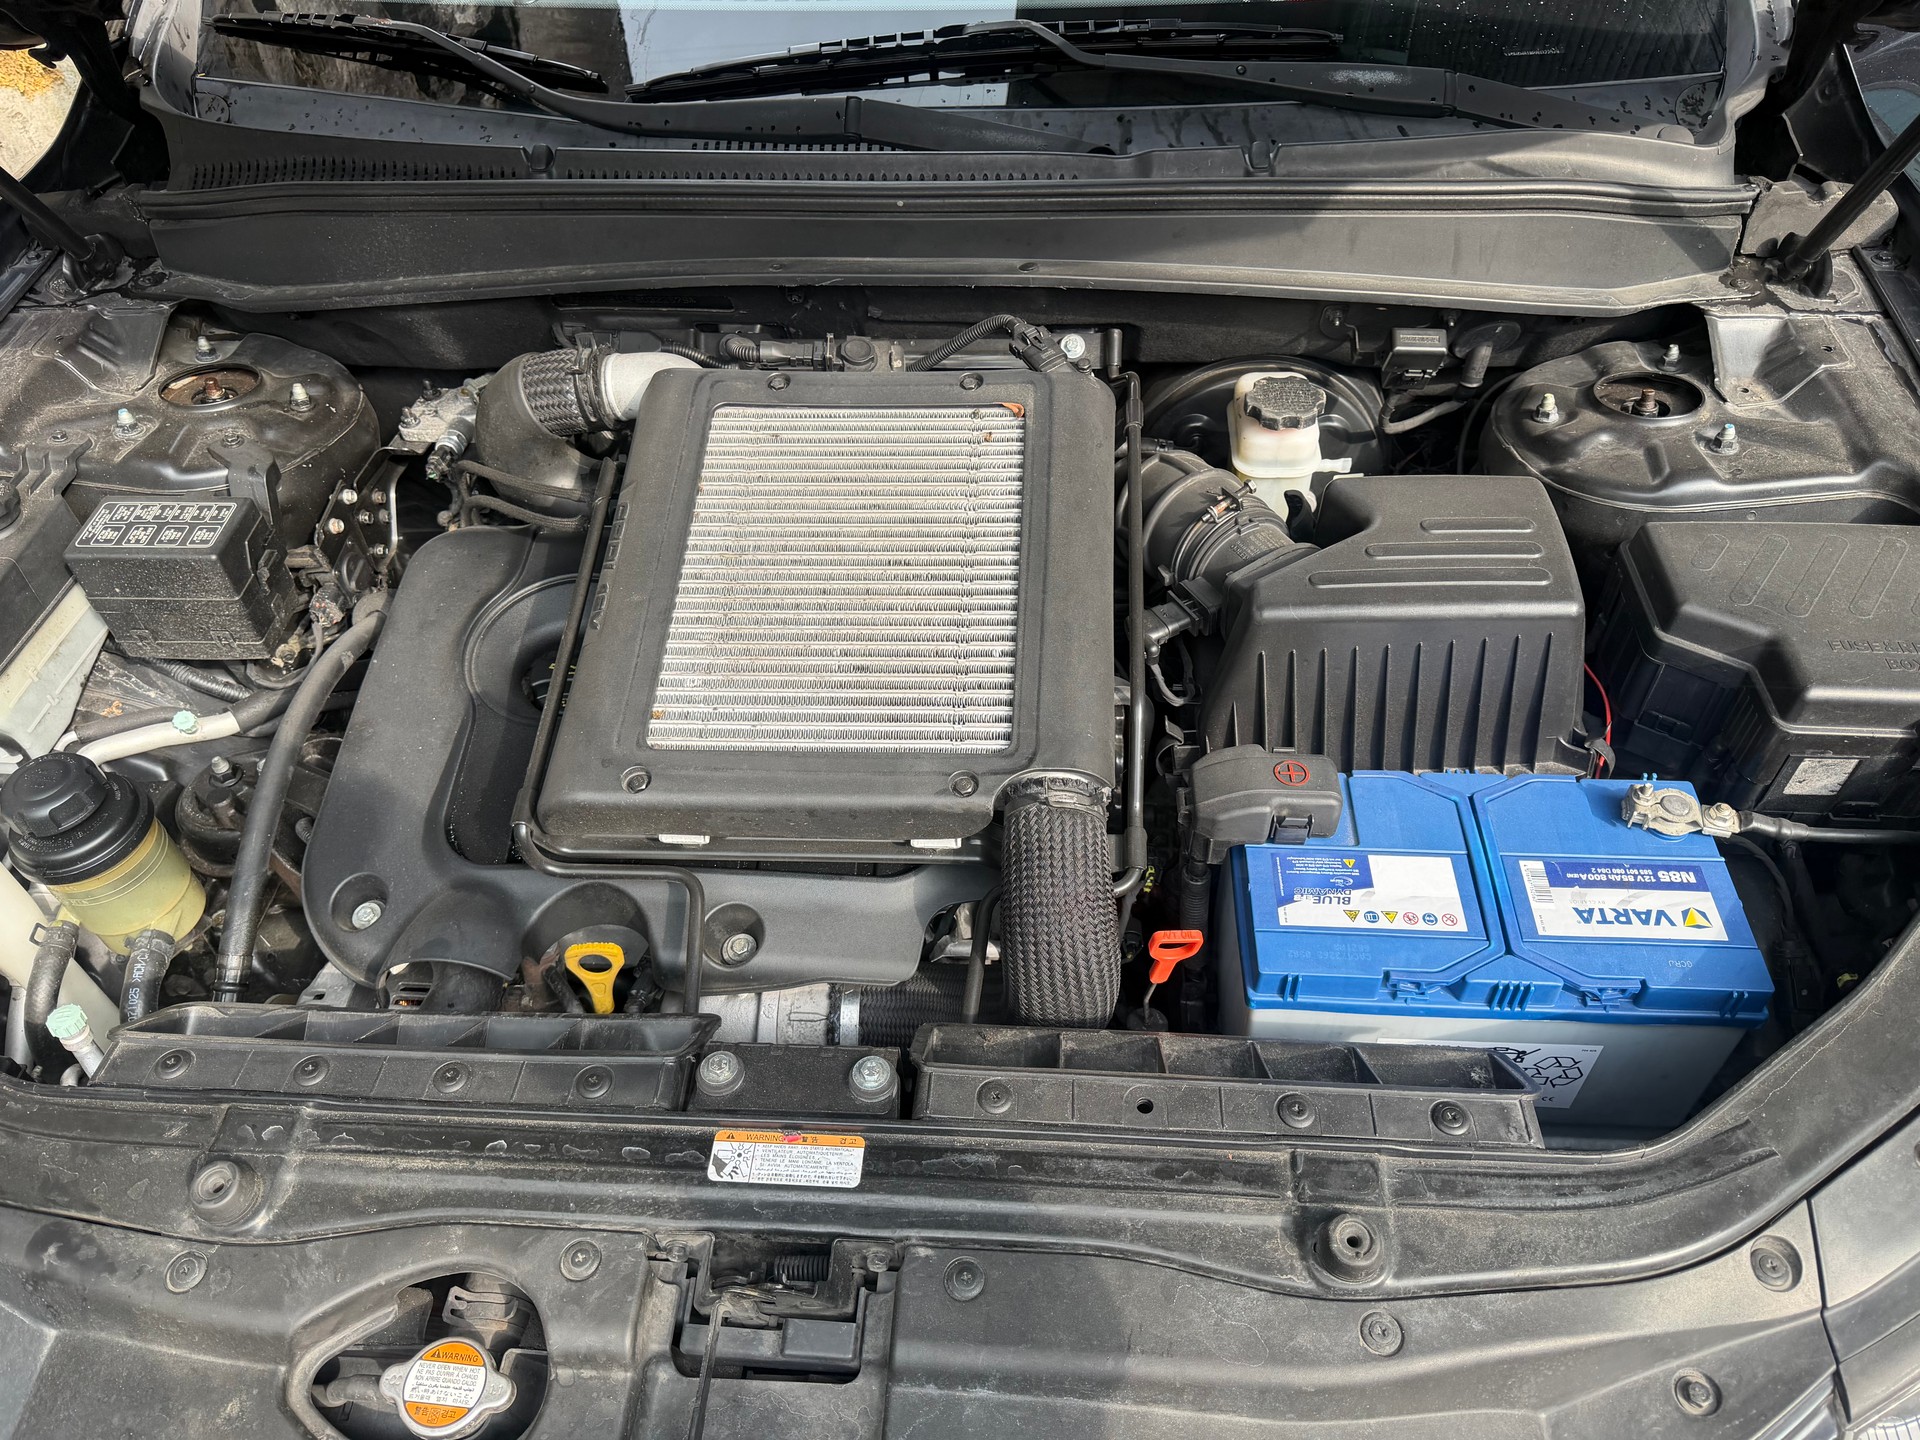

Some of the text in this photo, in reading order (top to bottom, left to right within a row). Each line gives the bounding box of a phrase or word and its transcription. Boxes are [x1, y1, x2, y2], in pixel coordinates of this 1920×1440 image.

[1609, 874, 1635, 882] 85Ah
[1657, 870, 1697, 883] N85
[1294, 886, 1352, 896] DYNAMIC
[1312, 895, 1351, 905] BLUE
[1572, 907, 1677, 927] VARTA
[441, 1352, 479, 1363] WARNING
